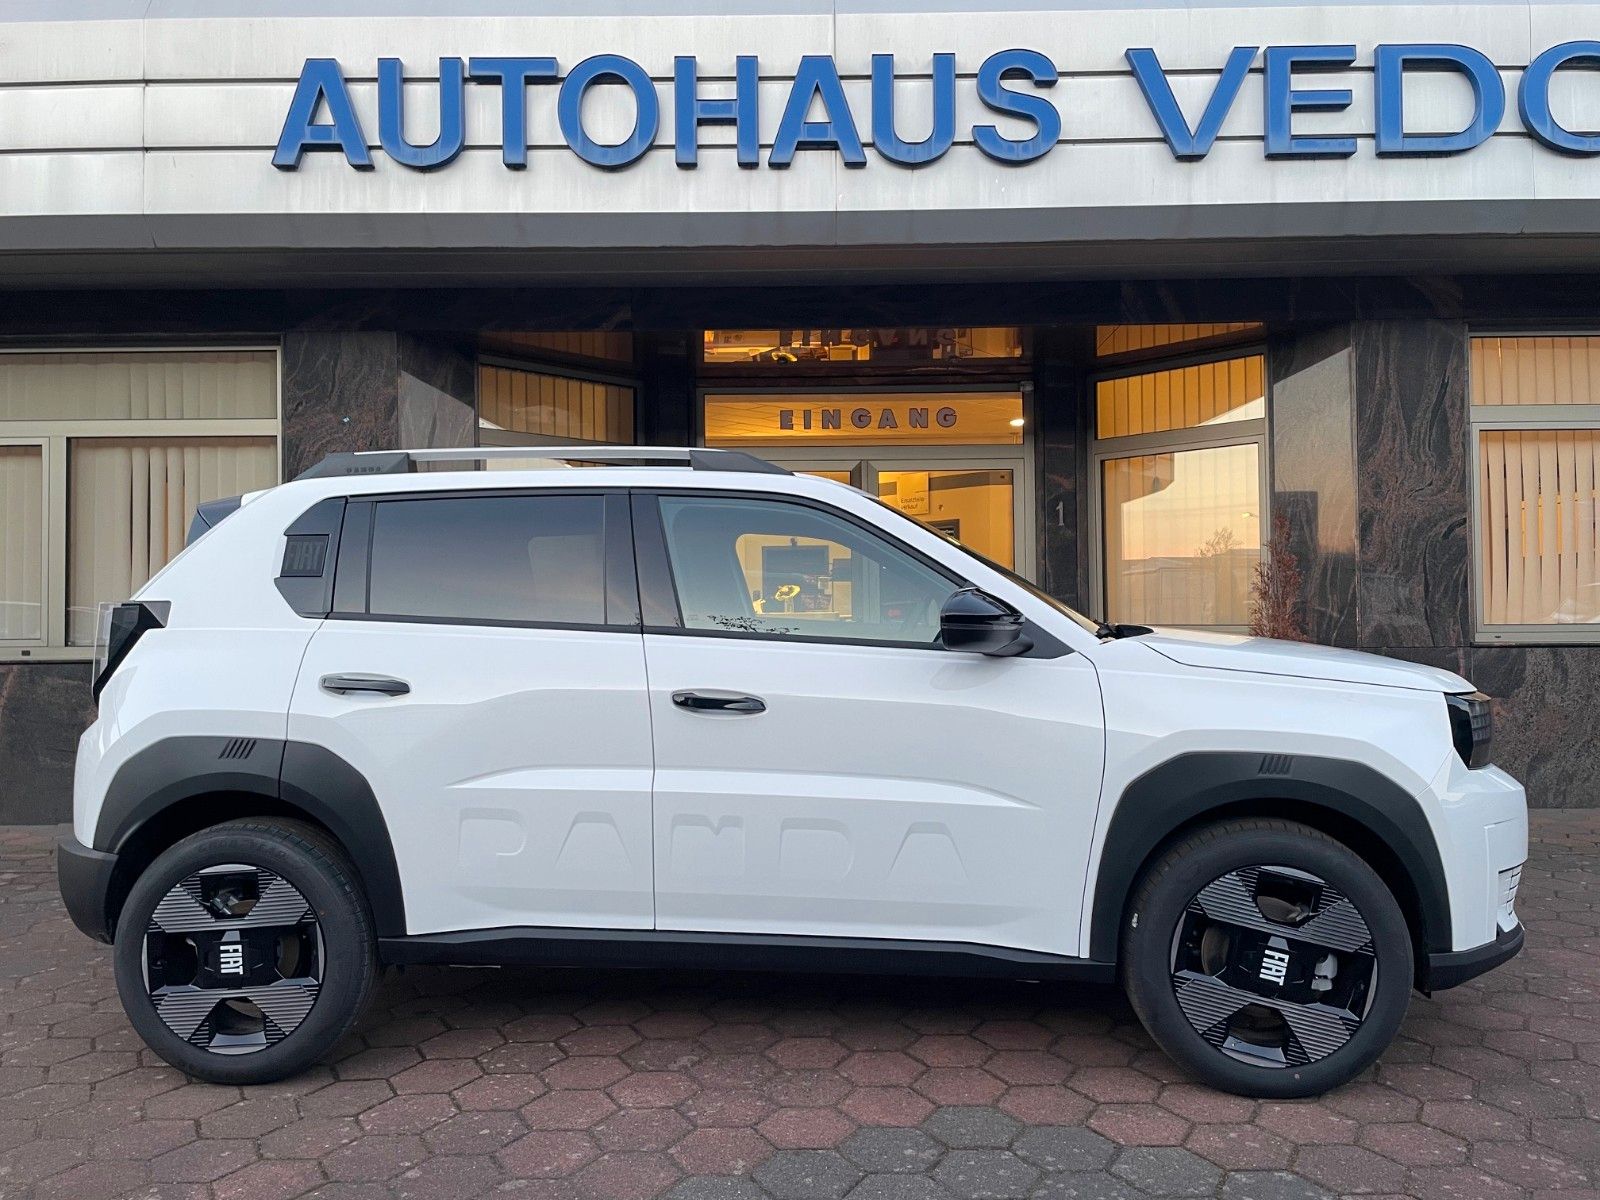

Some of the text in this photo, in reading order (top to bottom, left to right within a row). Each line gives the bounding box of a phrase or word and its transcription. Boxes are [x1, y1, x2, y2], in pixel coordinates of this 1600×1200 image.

[271, 47, 1062, 171] AUTOHAUS
[780, 407, 957, 430] EINGANG
[1055, 500, 1065, 527] 1
[219, 944, 243, 975] FIAT
[1258, 949, 1290, 986] FIAT
